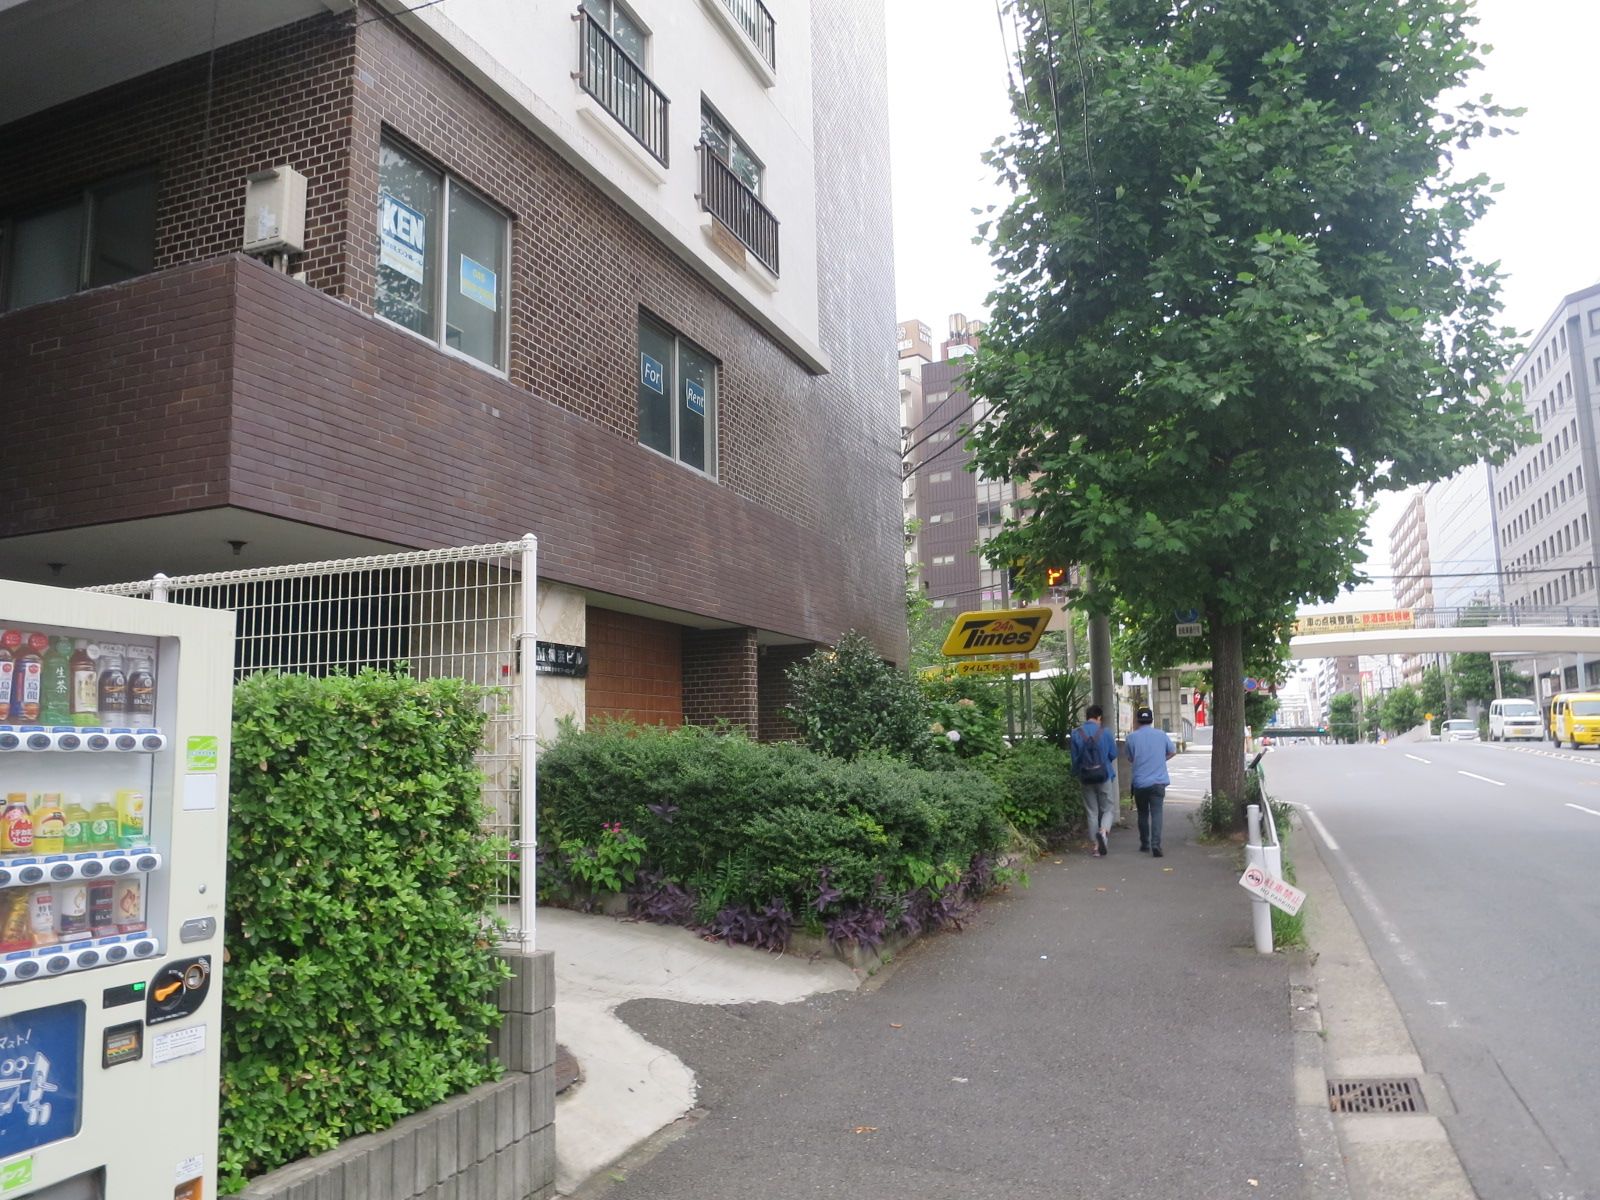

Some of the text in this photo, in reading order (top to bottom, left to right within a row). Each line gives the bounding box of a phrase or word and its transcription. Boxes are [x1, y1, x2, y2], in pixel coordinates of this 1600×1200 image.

[383, 199, 424, 251] KEN
[644, 362, 660, 384] For
[688, 387, 704, 408] Rent
[961, 618, 1038, 649] Times
[991, 621, 1014, 632] 24h
[963, 663, 991, 673] タイムズ
[56, 666, 67, 694] 生茶
[1260, 887, 1269, 895] NO
